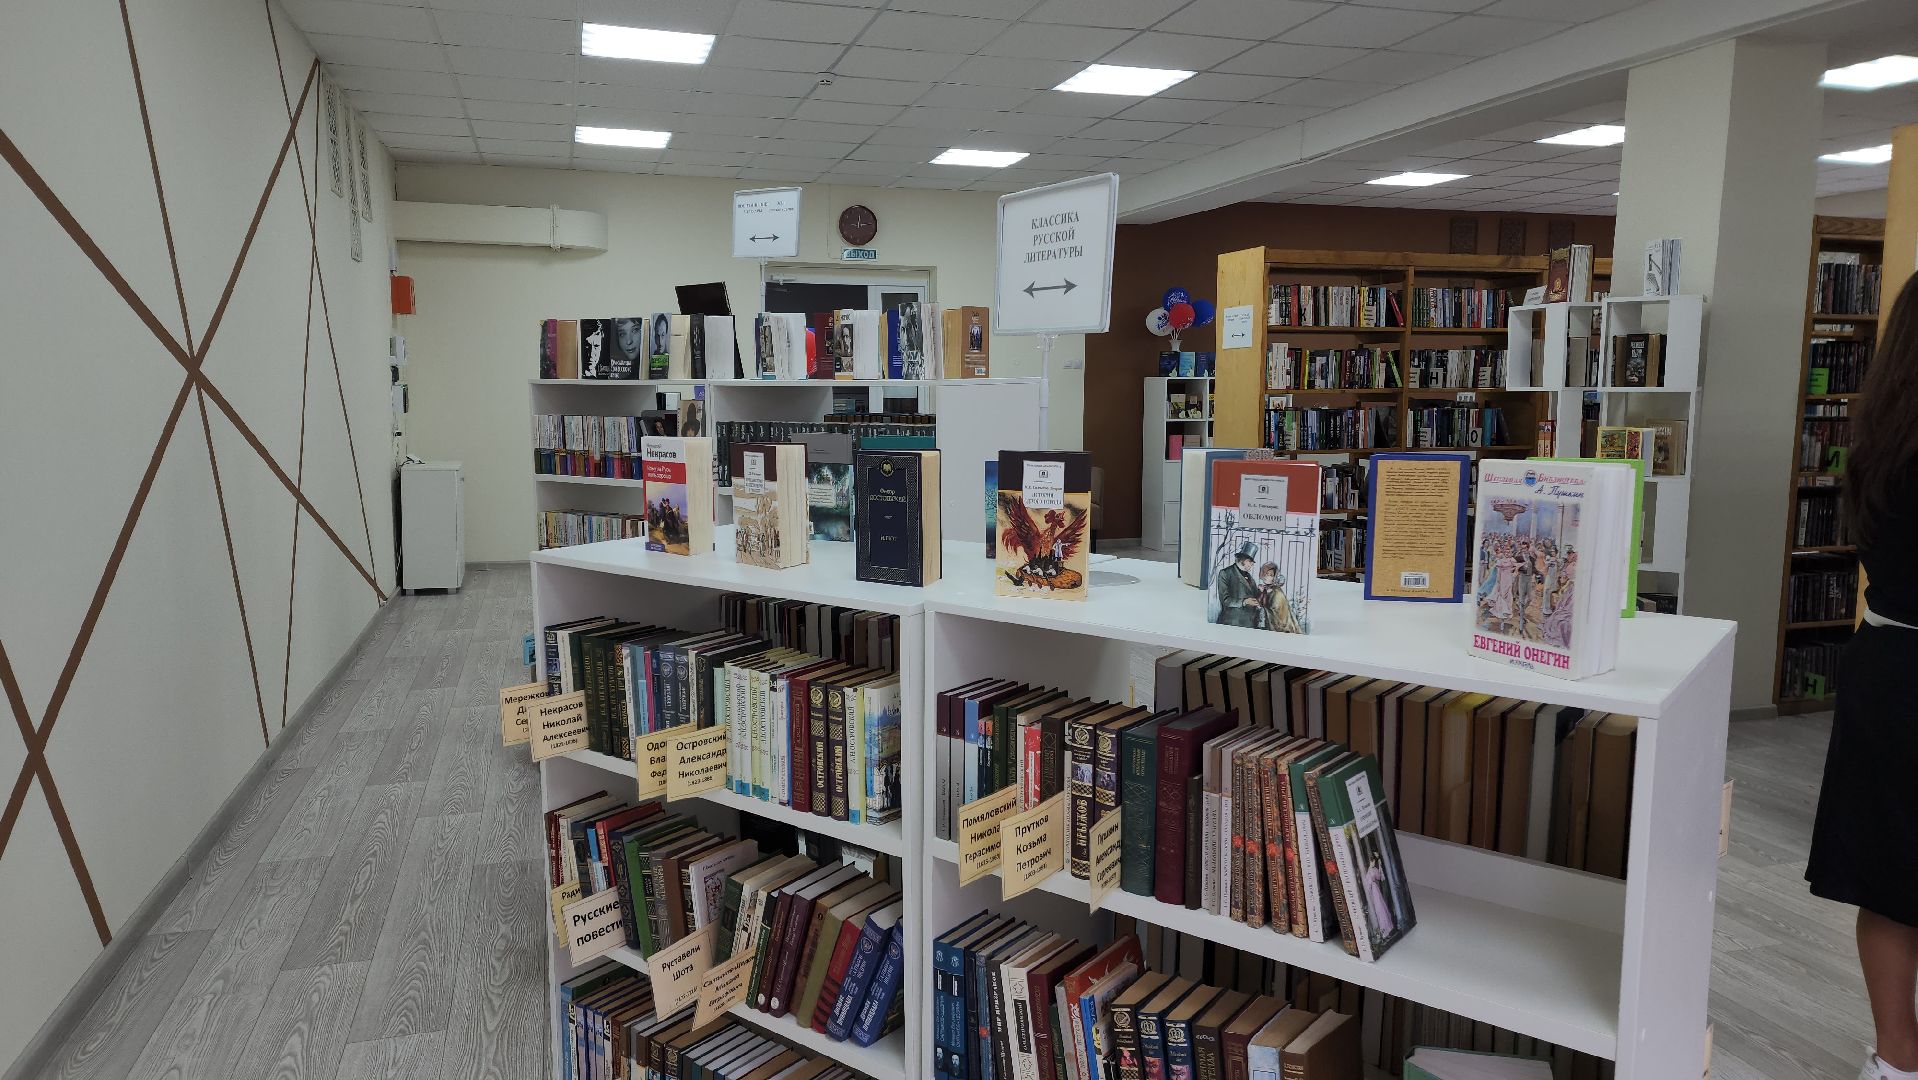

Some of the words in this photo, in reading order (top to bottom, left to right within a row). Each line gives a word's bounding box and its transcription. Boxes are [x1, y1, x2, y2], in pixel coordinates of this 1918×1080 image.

[1031, 211, 1080, 230] КЛАССИКА
[1033, 226, 1075, 246] РУССКОЙ
[846, 250, 875, 259] ВЫХОД
[1023, 245, 1083, 264] ЛИТЕРАТУРЫ
[646, 448, 677, 460] Некрасов
[1547, 486, 1585, 498] Пушкин
[1243, 513, 1282, 521] ОБЛОМОВ
[1473, 634, 1521, 659] ЕВГЕНИЙ
[1524, 646, 1570, 669] ОНЕГИН
[539, 701, 584, 717] Некрасов
[542, 713, 583, 730] Николай
[542, 725, 591, 743] Алексеевич
[676, 730, 727, 752] Островский
[678, 748, 727, 766] Александр
[815, 741, 825, 789] ОСТРОВСКИЙ
[678, 761, 727, 779] Николаевич
[833, 745, 843, 793] ОСТРОВСКИЙ
[962, 798, 1017, 829] Помяловский
[1075, 798, 1088, 847] ПРЫЖОВ
[970, 823, 1001, 845] Никола
[1015, 814, 1049, 838] Прутков
[1097, 822, 1119, 846] Пушкин
[965, 841, 1001, 864] Герасимо
[1016, 833, 1047, 856] Козьма
[1016, 847, 1052, 873] Петрович
[572, 901, 620, 928] Русские
[576, 919, 624, 947] повести
[661, 945, 701, 973] Руставели
[672, 963, 695, 982] Шота
